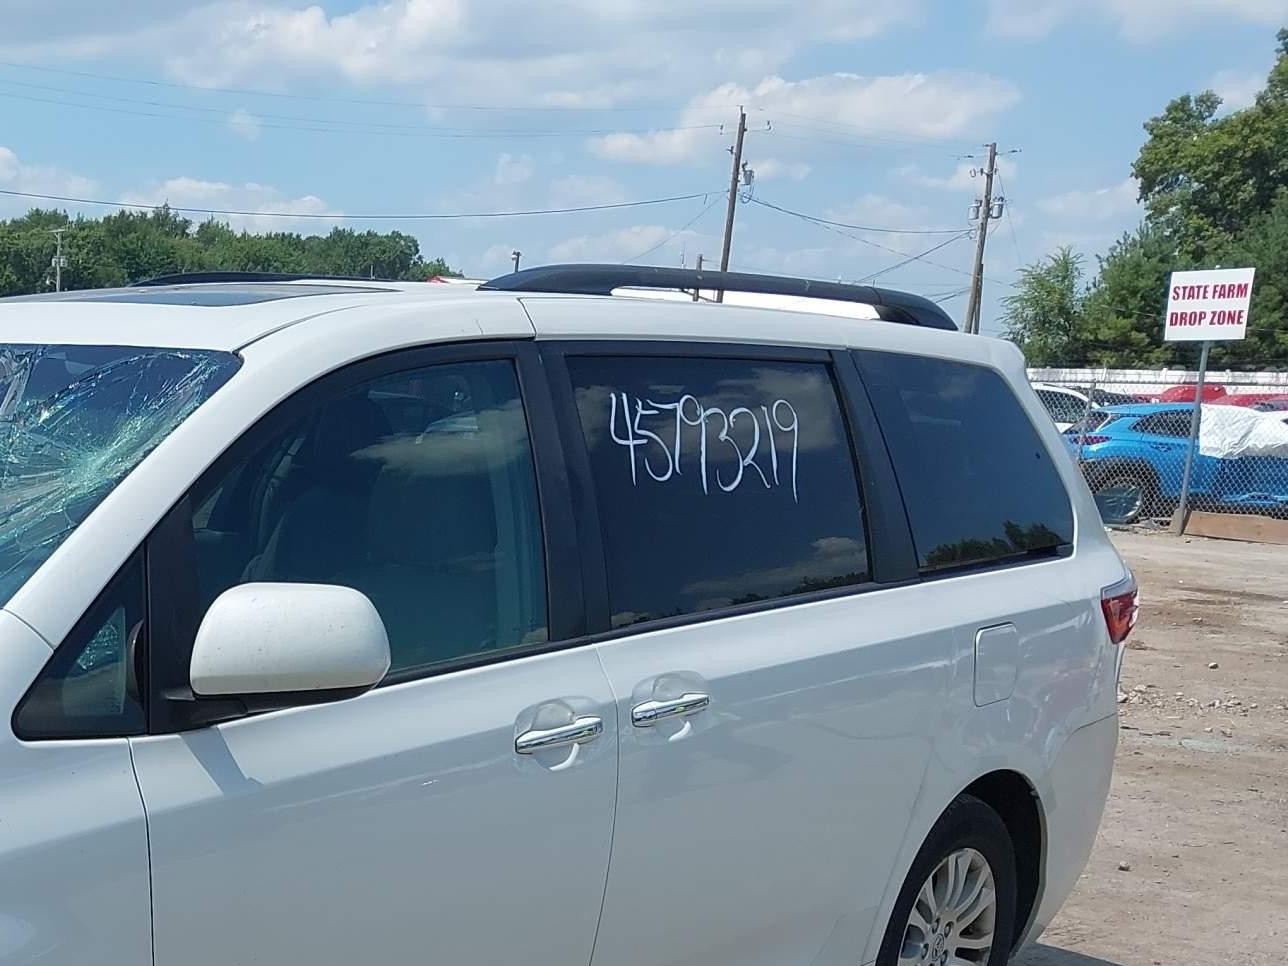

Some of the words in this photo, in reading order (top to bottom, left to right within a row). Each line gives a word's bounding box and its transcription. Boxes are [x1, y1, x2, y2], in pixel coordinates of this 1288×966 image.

[1172, 285, 1210, 301] STATE
[1212, 283, 1249, 299] FARM
[1170, 312, 1206, 326] DROP
[1209, 309, 1244, 325] ZONE
[610, 392, 799, 504] 45793219
